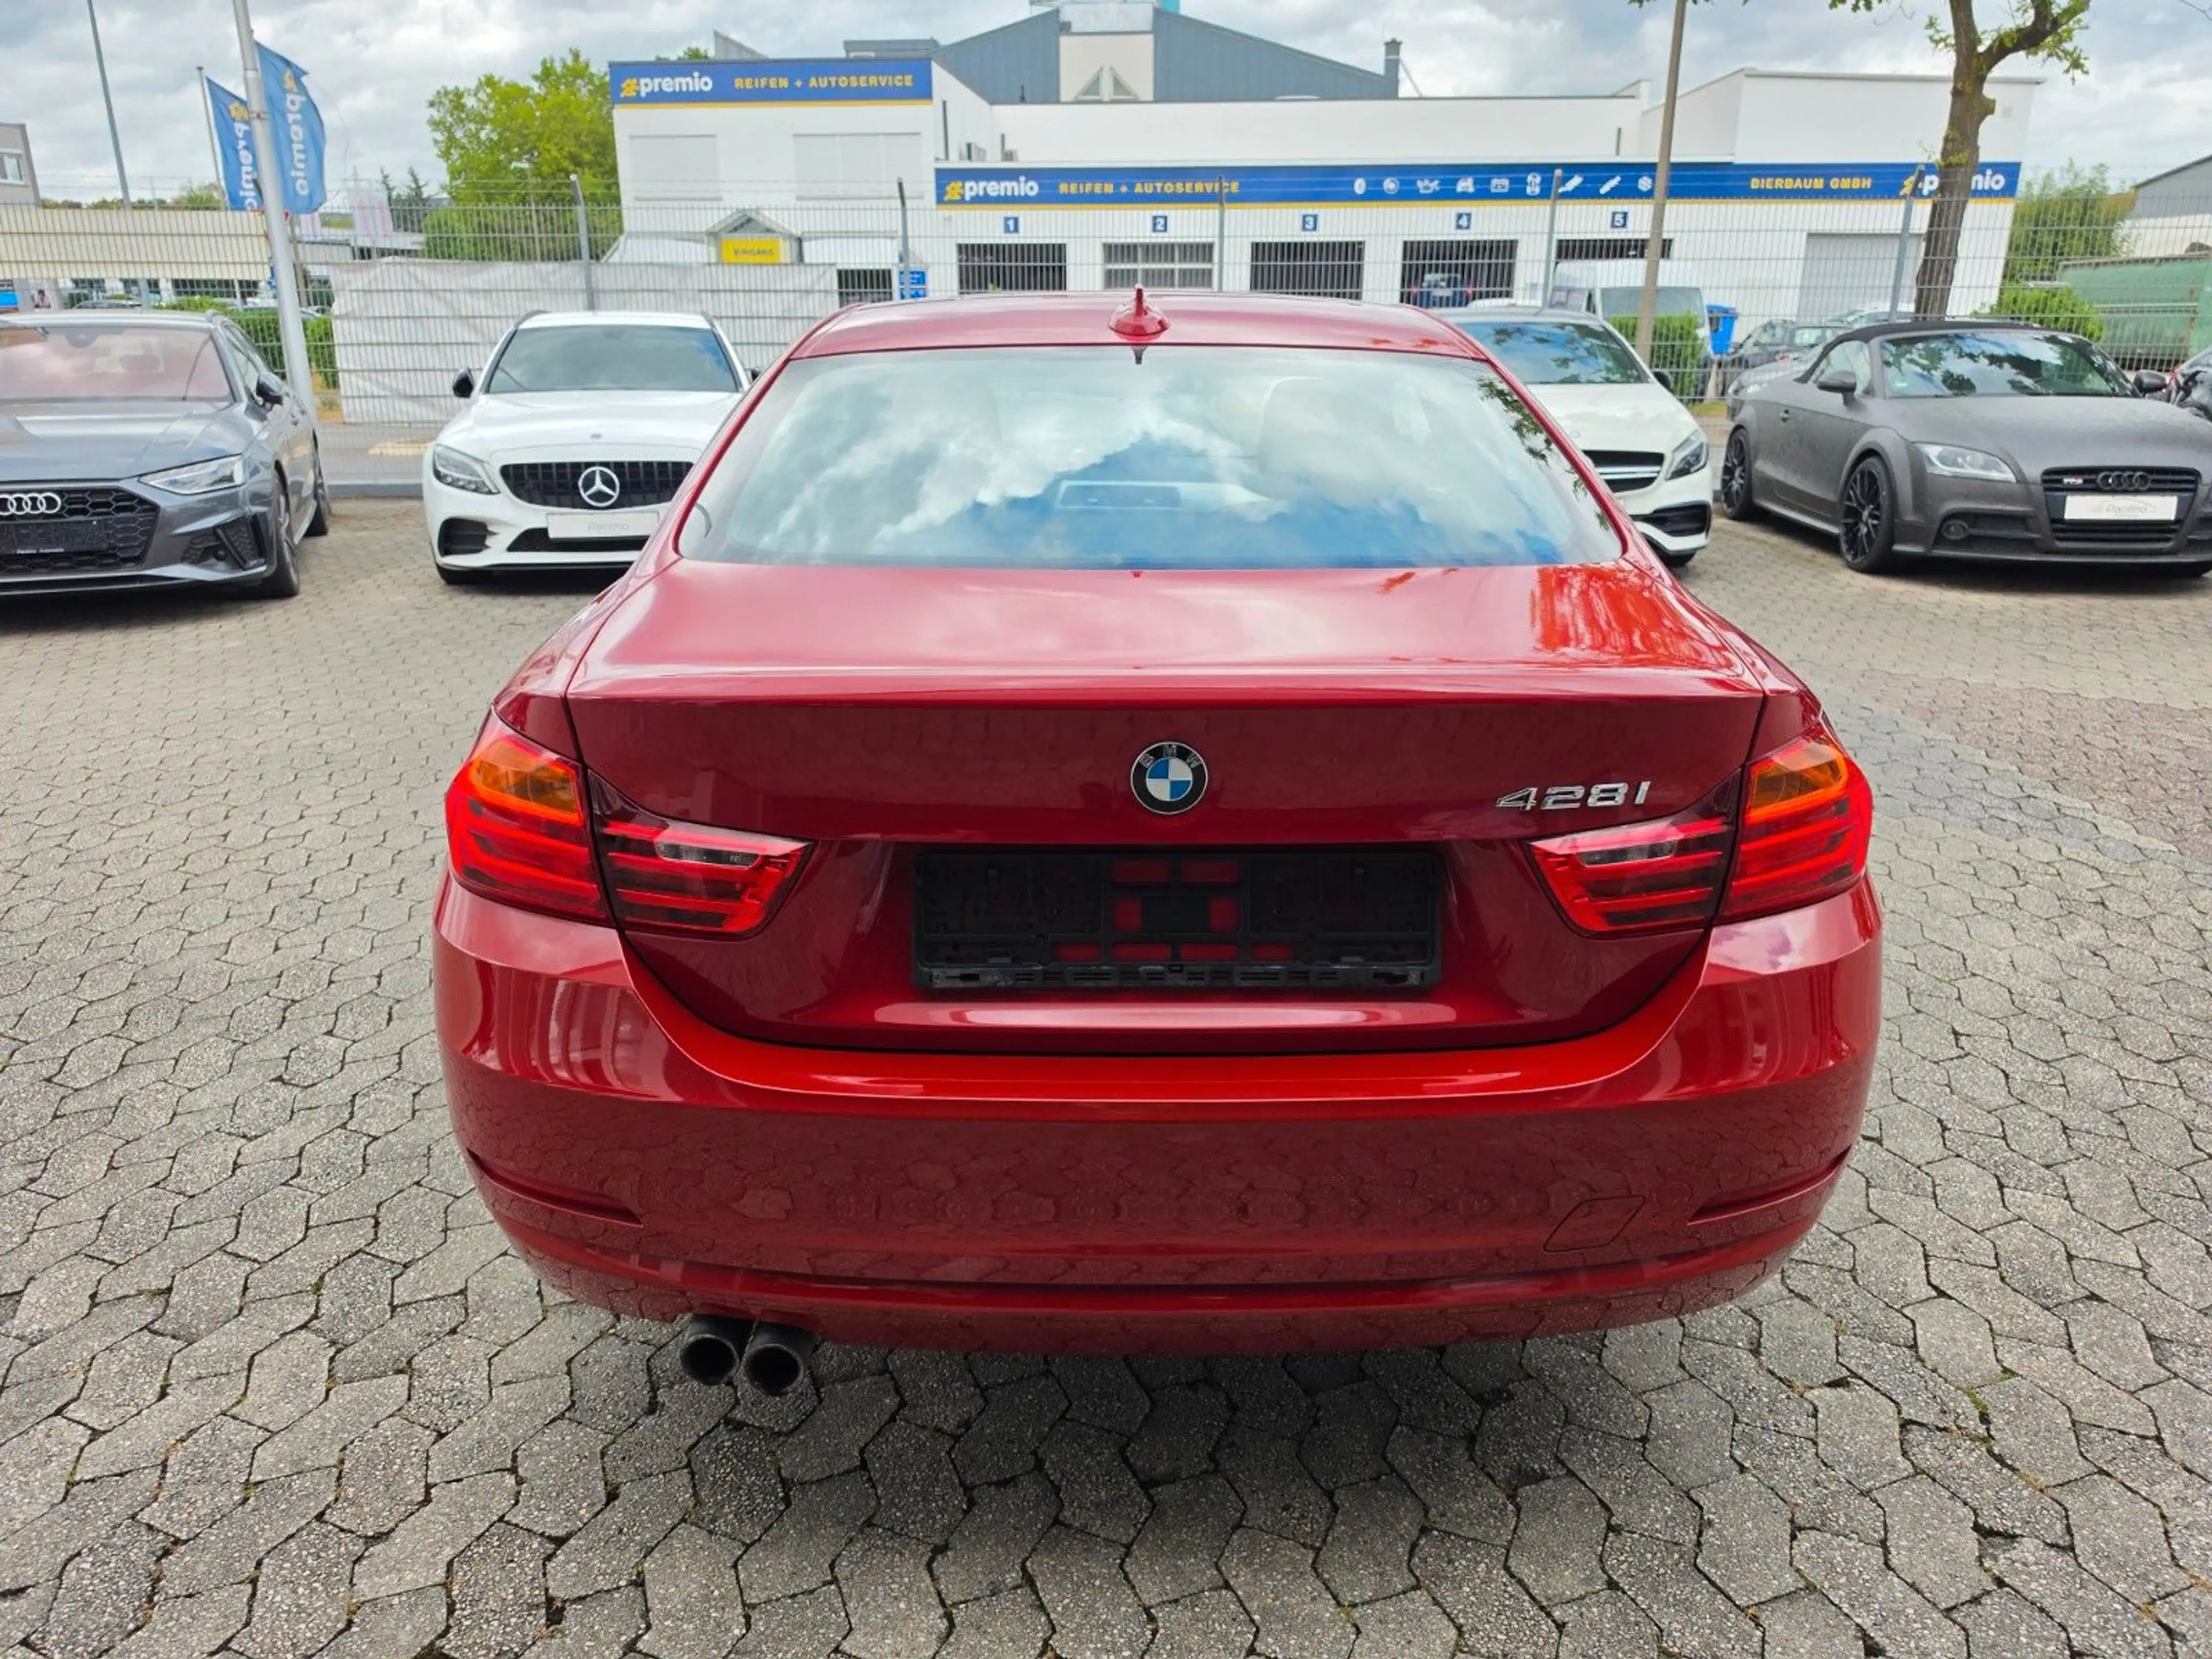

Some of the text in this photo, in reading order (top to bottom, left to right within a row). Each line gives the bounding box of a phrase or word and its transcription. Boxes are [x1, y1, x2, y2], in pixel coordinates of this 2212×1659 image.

[639, 71, 713, 97] premio
[734, 77, 789, 89] REIFEN
[809, 75, 914, 88] AUTOSERVICE
[964, 175, 1039, 201] premio
[1059, 183, 1114, 194] REIFEN
[1750, 177, 1872, 189] BIERBAUM GMBH
[1006, 218, 1015, 232] 1
[1155, 218, 1165, 231] 2
[1304, 216, 1314, 229] 3
[1457, 215, 1468, 228] 4
